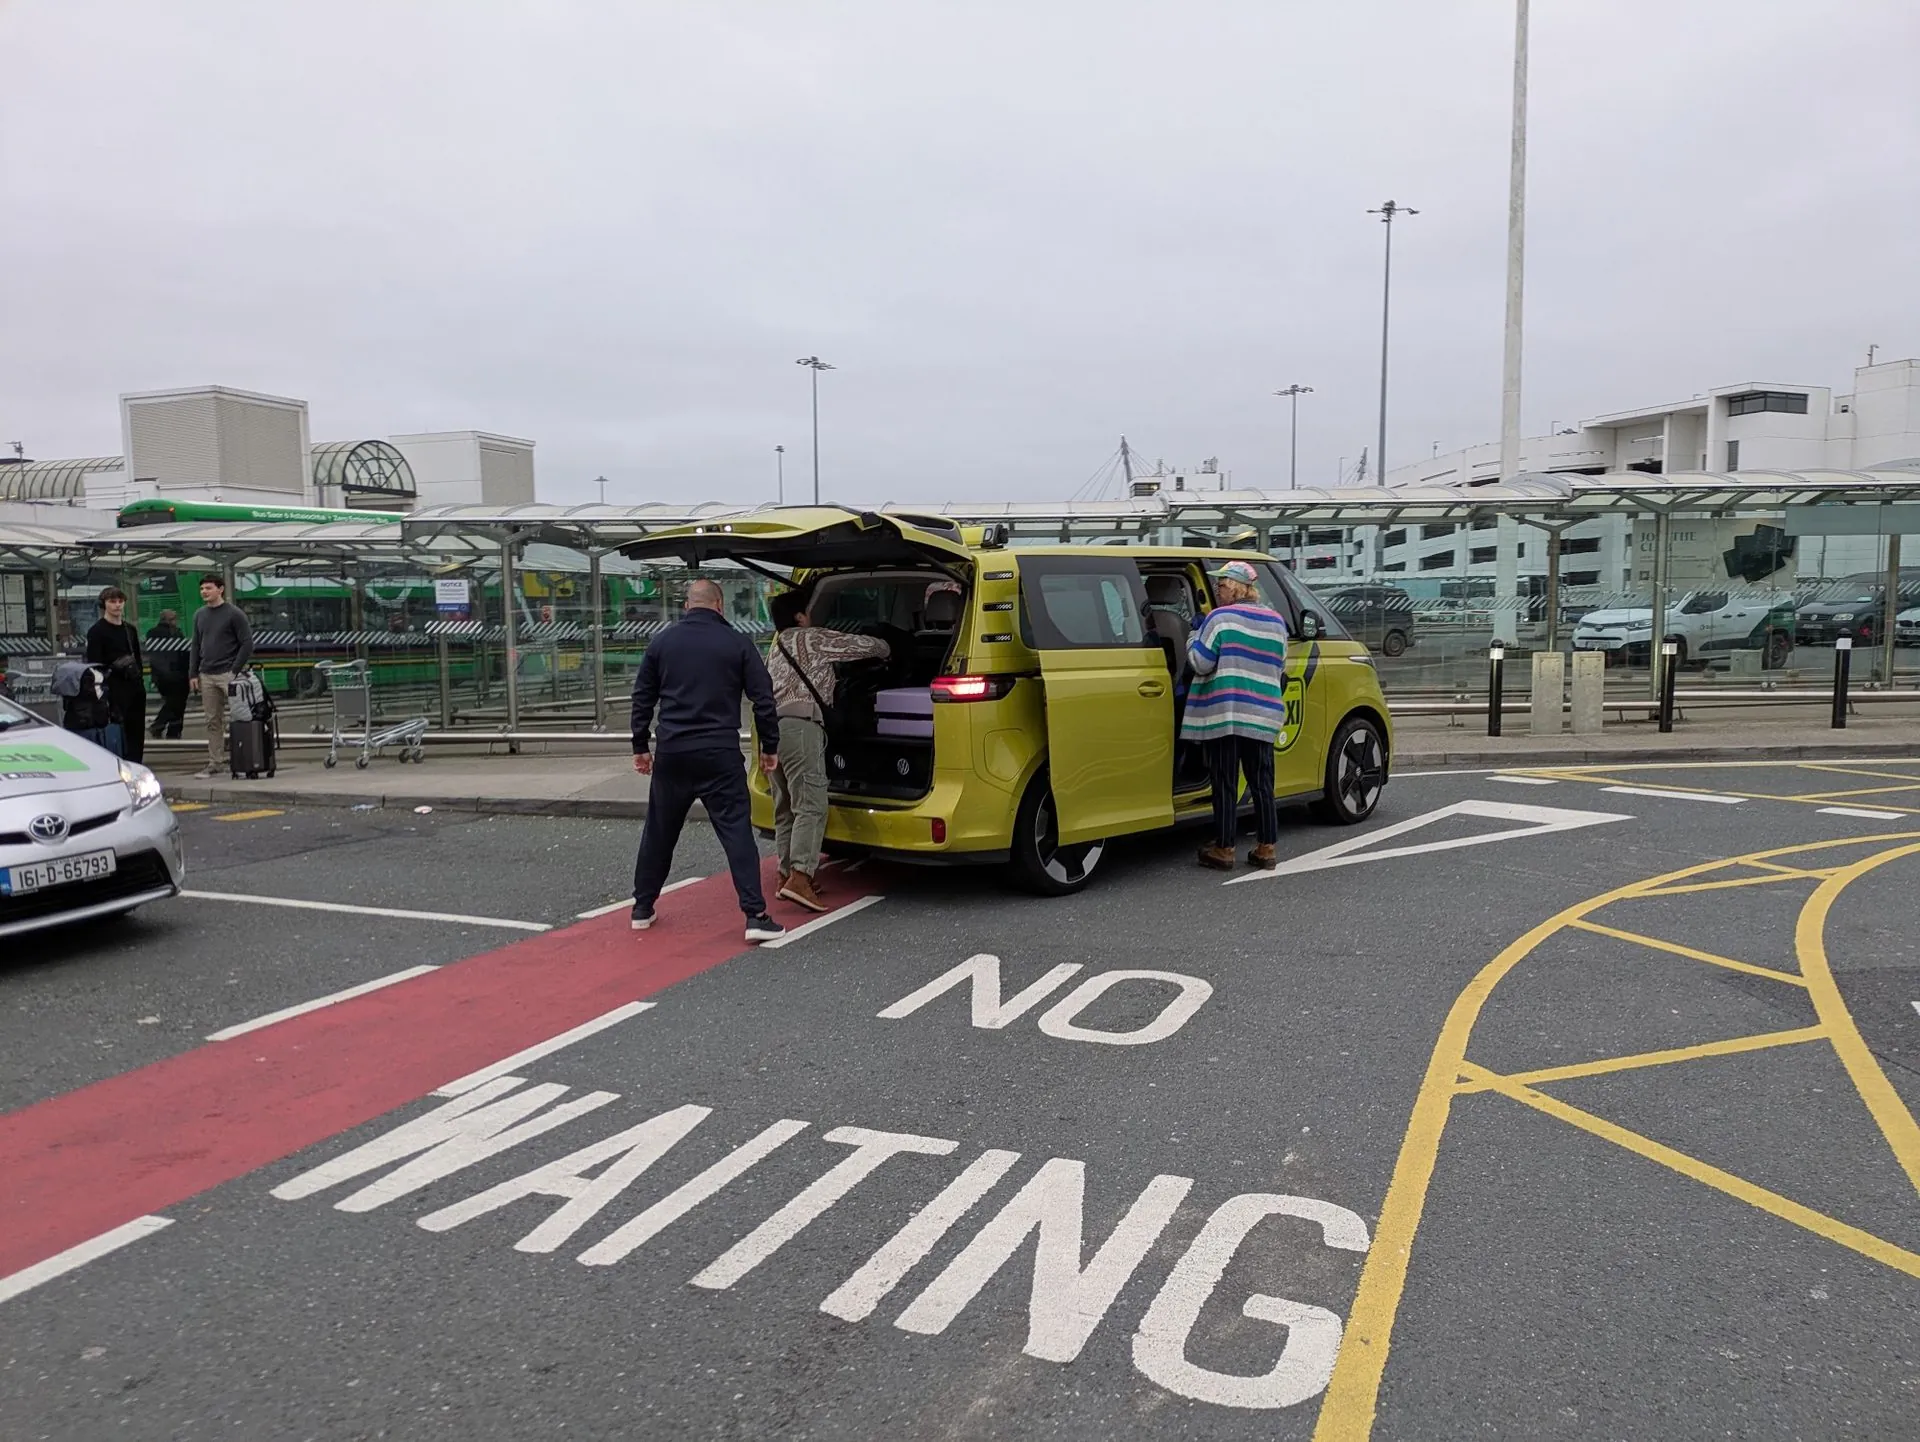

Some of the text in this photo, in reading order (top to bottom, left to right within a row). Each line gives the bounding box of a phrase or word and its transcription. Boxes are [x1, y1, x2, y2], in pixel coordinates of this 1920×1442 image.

[1671, 532, 1697, 541] THE
[1284, 700, 1300, 726] XI
[19, 855, 109, 889] 161-D-65793
[876, 952, 1213, 1047] NO
[268, 1075, 1371, 1410] WAITING
